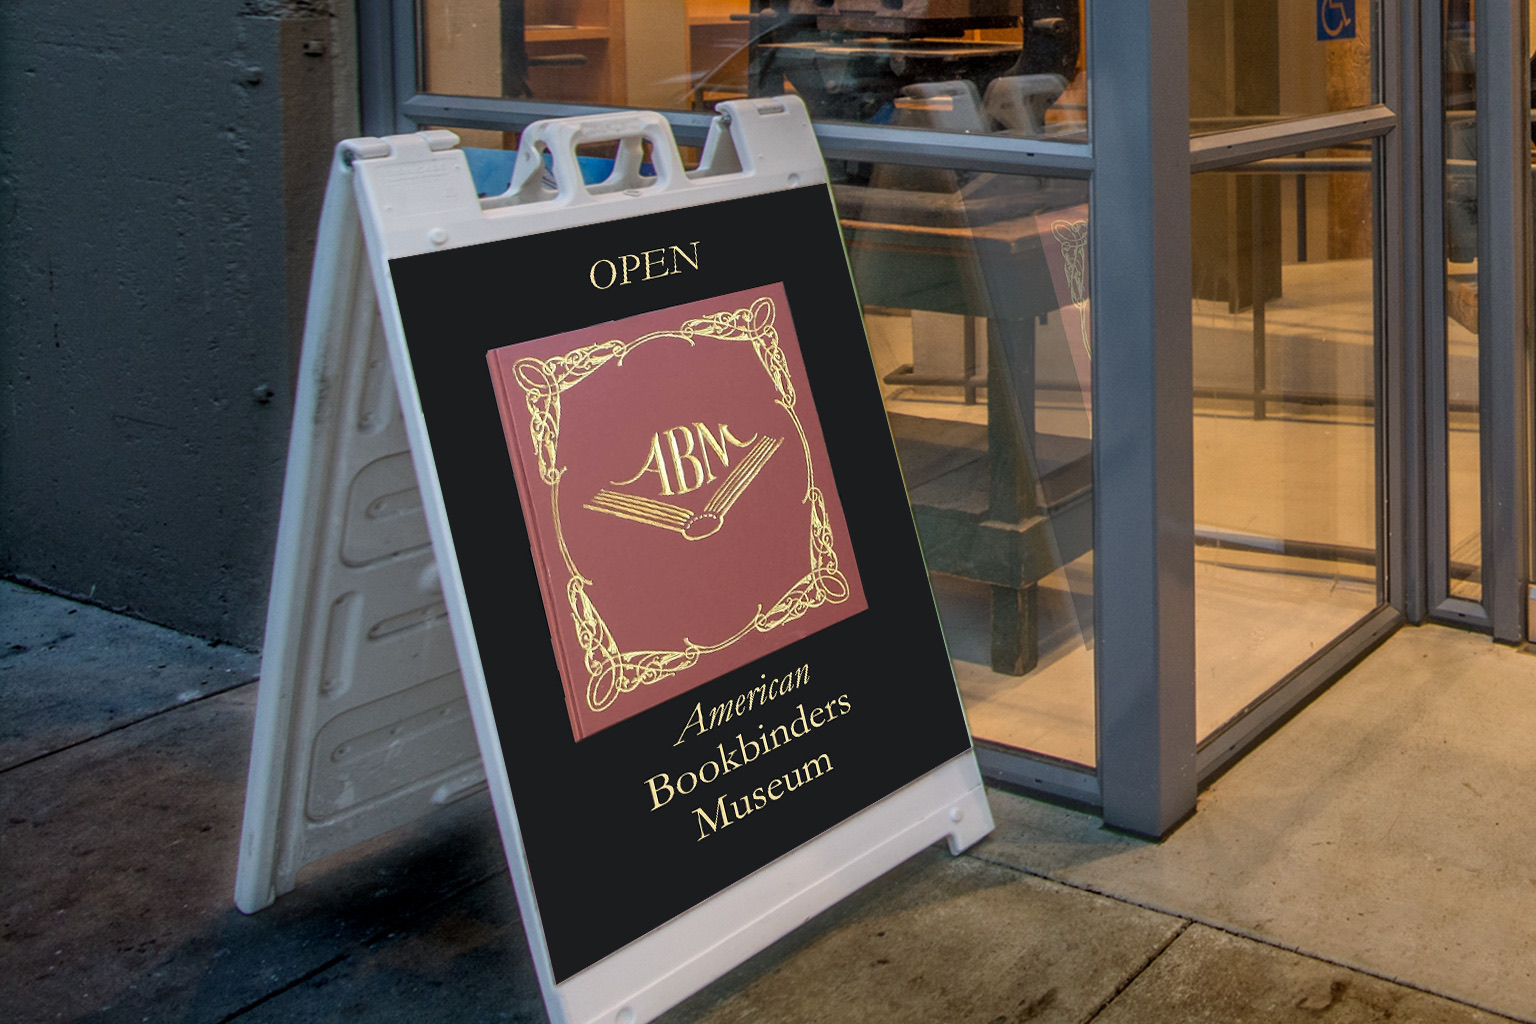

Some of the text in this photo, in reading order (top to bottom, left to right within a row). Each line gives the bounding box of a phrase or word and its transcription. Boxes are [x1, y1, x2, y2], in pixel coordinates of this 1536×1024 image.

[589, 241, 701, 290] OPEN
[610, 422, 758, 496] ABM
[672, 663, 811, 747] American
[643, 693, 852, 812] Bookbinders
[691, 751, 834, 842] Museum
